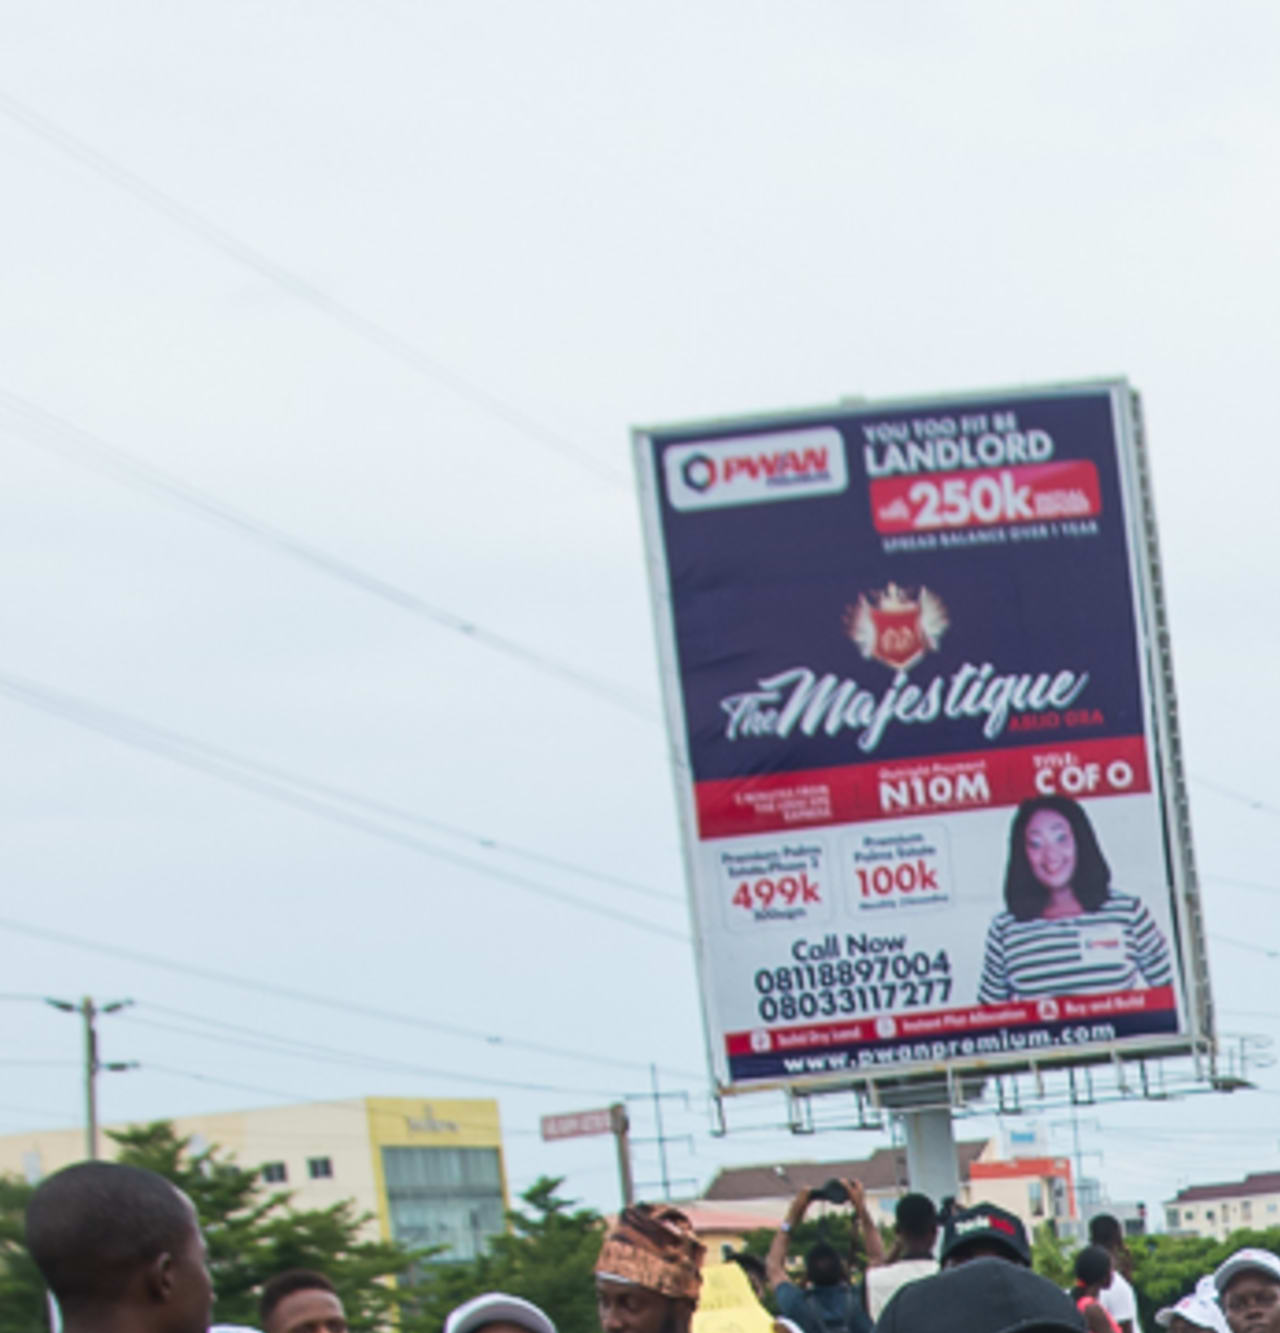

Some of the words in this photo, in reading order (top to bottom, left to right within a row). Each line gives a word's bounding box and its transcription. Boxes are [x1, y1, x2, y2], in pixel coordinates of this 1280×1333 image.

[863, 424, 908, 444] YOU
[913, 418, 957, 439] TOO
[723, 446, 828, 483] PWAN
[864, 428, 1054, 477] LANDLORD
[909, 470, 1033, 528] 250k
[720, 690, 781, 740] The
[759, 662, 1090, 752] Majestique
[1035, 768, 1056, 794] C
[1060, 763, 1100, 793] OF
[1106, 760, 1133, 788] O
[732, 871, 822, 910] 499k
[855, 858, 939, 898] 100k
[790, 934, 841, 963] Call
[846, 933, 907, 956] Now
[754, 950, 951, 995] 08118897004
[758, 978, 953, 1023] 08033117277
[783, 1022, 1116, 1073] www.pwanpremium.com
